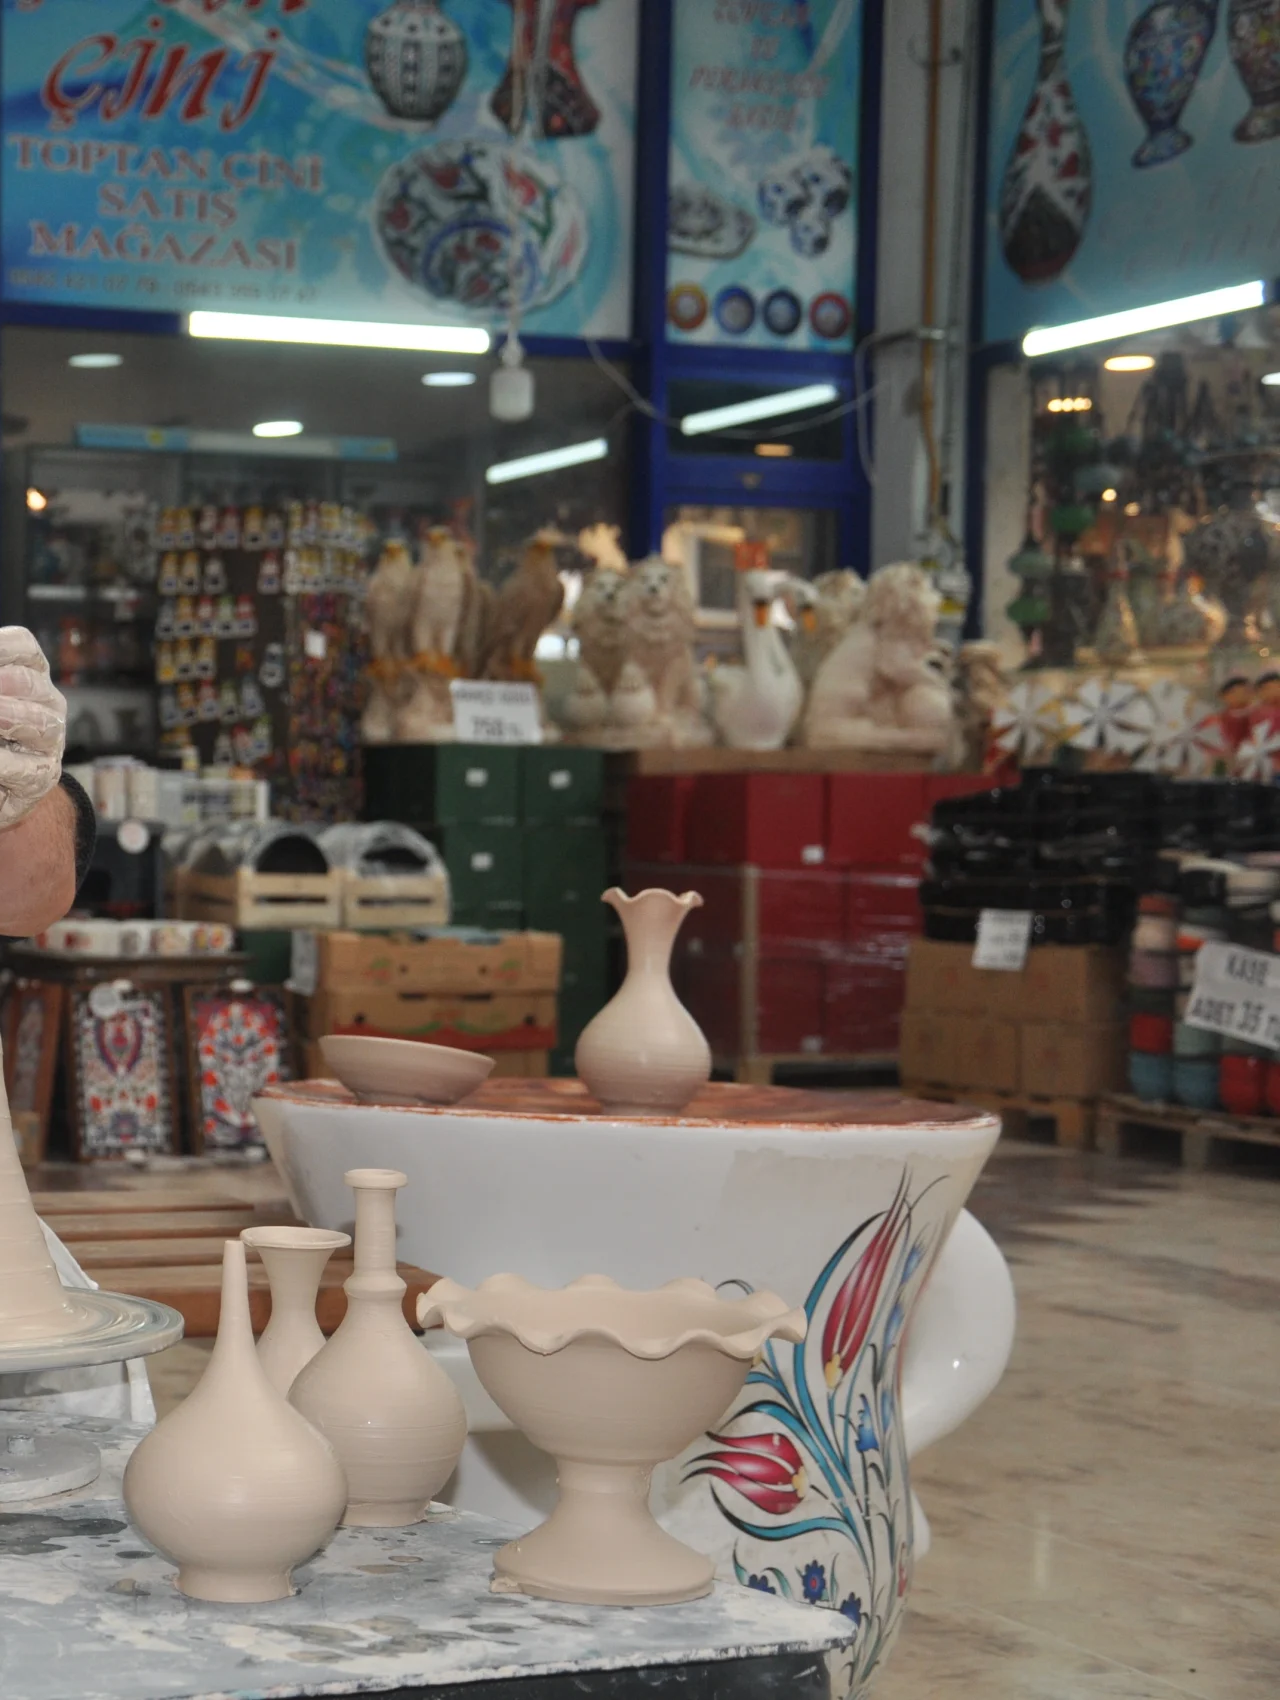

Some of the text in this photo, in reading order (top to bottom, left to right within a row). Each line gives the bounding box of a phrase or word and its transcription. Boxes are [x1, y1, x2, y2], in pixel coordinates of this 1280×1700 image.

[7, 134, 210, 180] TOPTAN
[100, 183, 238, 230] SATIŞ
[28, 220, 299, 275] MAĞAZASI
